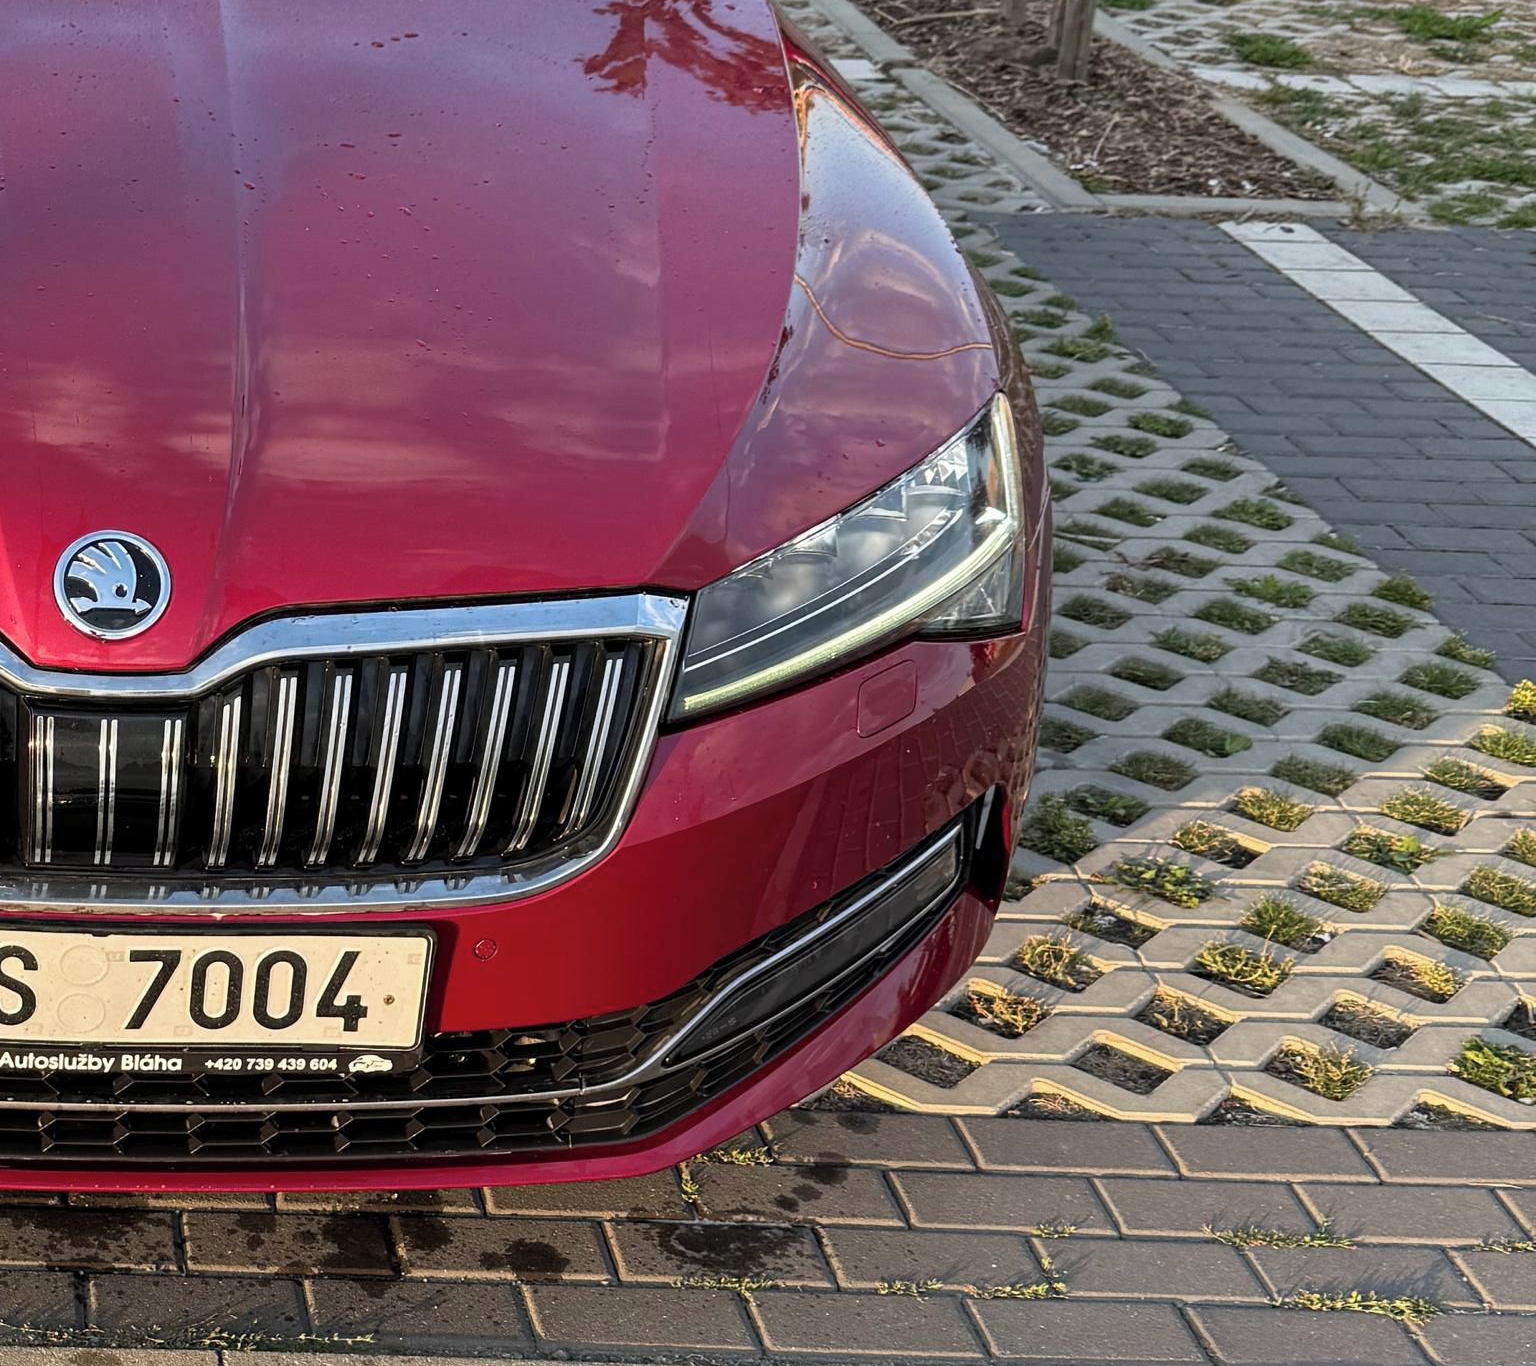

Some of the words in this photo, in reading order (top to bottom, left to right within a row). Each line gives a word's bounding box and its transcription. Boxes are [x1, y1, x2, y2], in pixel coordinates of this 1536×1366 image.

[125, 949, 368, 1032] 7004
[121, 1054, 182, 1071] Bláha
[204, 1057, 242, 1070] +420
[246, 1058, 274, 1071] 739
[277, 1058, 306, 1071] 439
[309, 1058, 337, 1071] 604
